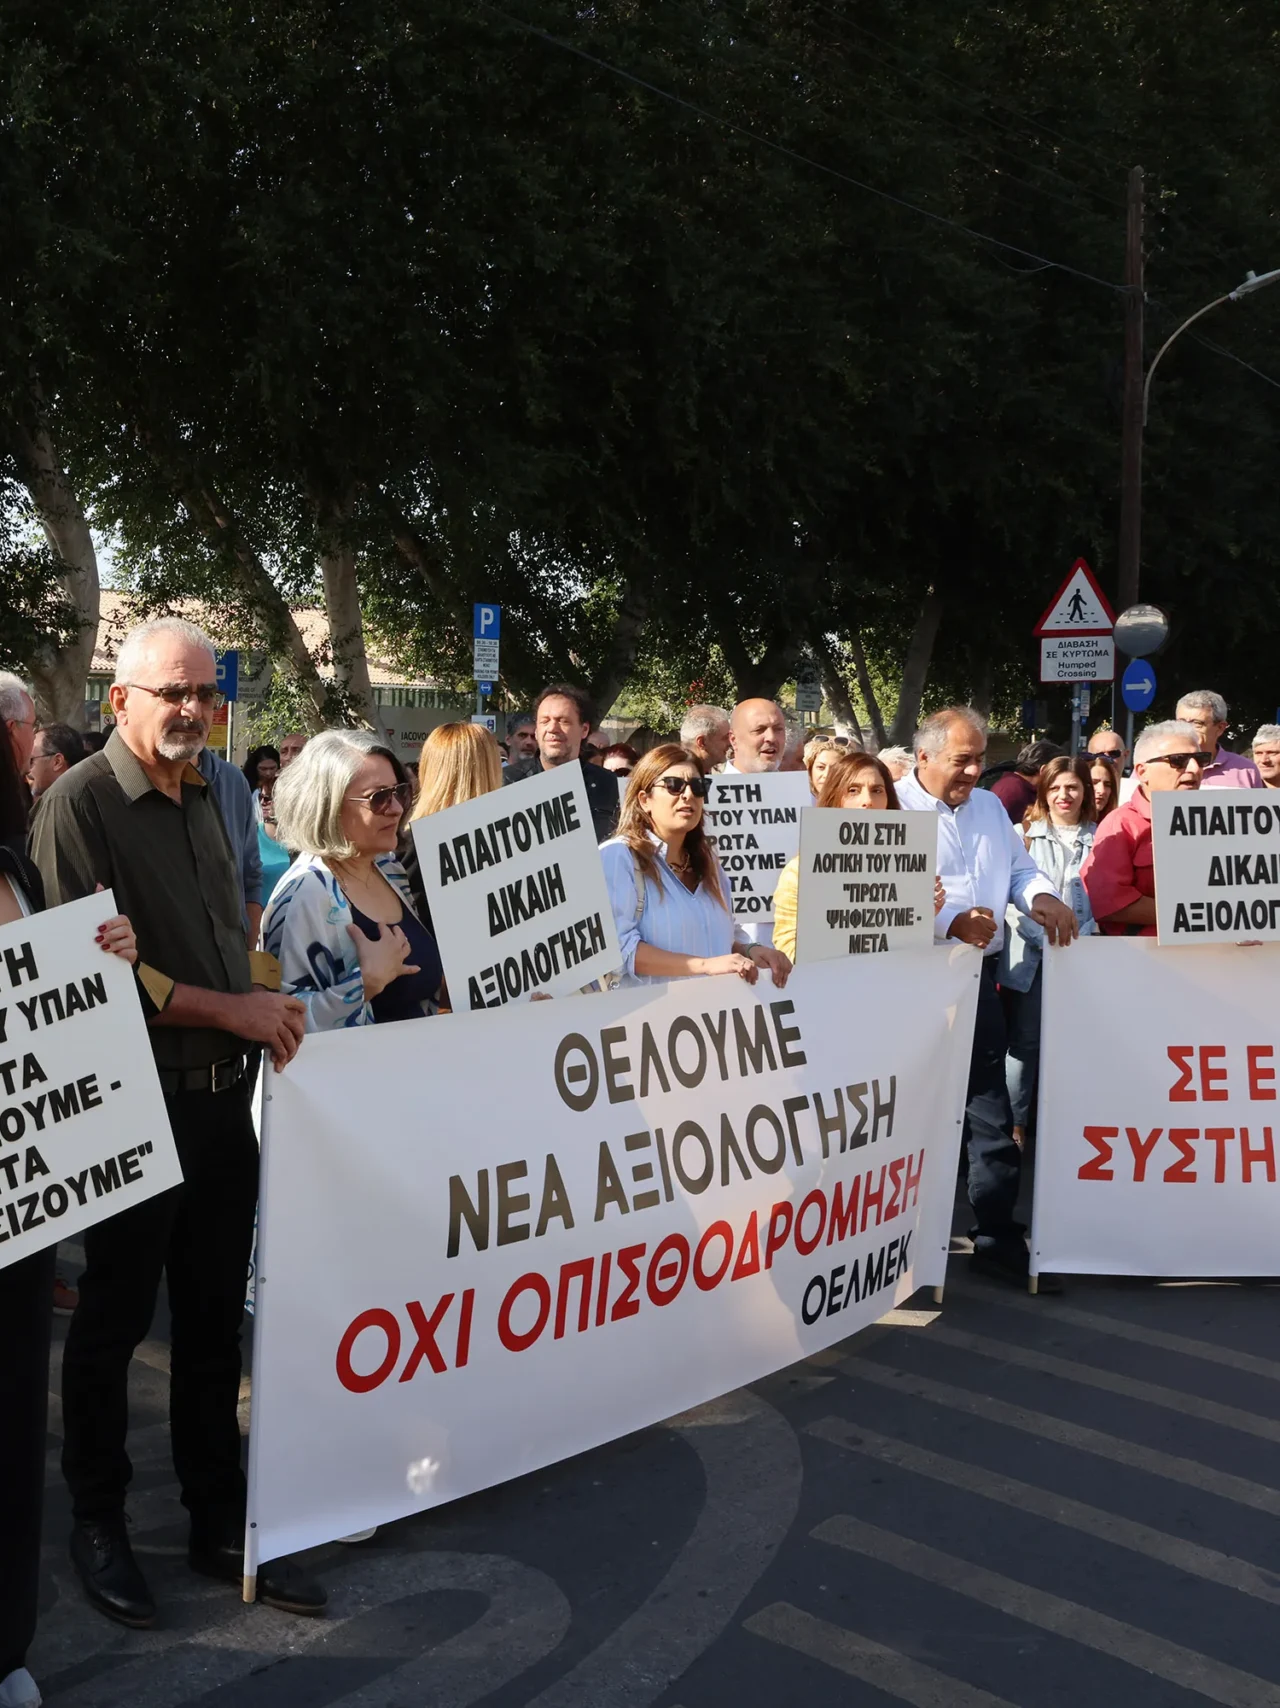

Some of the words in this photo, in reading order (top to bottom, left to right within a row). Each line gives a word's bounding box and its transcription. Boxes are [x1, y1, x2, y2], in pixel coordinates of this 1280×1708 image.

[481, 607, 494, 634] P
[1046, 651, 1058, 659] ΣΕ
[1062, 649, 1109, 658] ΚΥΡΤΩΜΑ
[1057, 640, 1098, 649] ΔΙΑΒΑΣΗ
[1057, 670, 1097, 678] Crossing
[1058, 661, 1096, 669] Humped
[401, 732, 429, 741] IACOVO
[716, 784, 762, 804] ΣΤΗ
[709, 810, 743, 826] ΤΟΥ
[748, 807, 797, 824] ΥΠΑΝ
[438, 791, 581, 887] ΑΠΑΙΤΟΥΜΕ
[839, 822, 869, 845] ΟΧΙ
[874, 823, 906, 845] ΣΤΗ
[812, 853, 863, 873] ΛΟΓΙΚΗ
[866, 854, 892, 873] ΤΟΥ
[895, 854, 927, 873] ΥΠΑΝ
[1207, 853, 1280, 887] ΔΙΚΑΙ
[487, 863, 566, 938] ΔΙΚΑΙΗ
[843, 883, 898, 903] "ΠΡΩΤΑ
[826, 908, 914, 929] ΨΗΦΙΖΟΥΜΕ
[849, 933, 889, 954] ΜΕΤΑ
[468, 912, 607, 1010] ΑΞΙΟΛΟΓΗΣΗ
[16, 972, 109, 1033] ΥΠΑΝ
[554, 1000, 807, 1112] ΘΕΛΟΥΜΕ
[1167, 1045, 1228, 1101] ΣΕ
[1246, 1045, 1277, 1100] Ε
[446, 1153, 575, 1258] ΝΕΑ
[593, 1075, 898, 1222] ΑΞΙΟΛΟΓΗΣΗ
[1077, 1126, 1277, 1183] ΣΥΣΤΗ
[336, 1289, 475, 1394] ΟΧΙ
[497, 1148, 926, 1353] ΟΠΙΣΘΟΔΡΟΜΗΣΗ
[801, 1230, 913, 1326] ΟΕΛΜΕΚ
